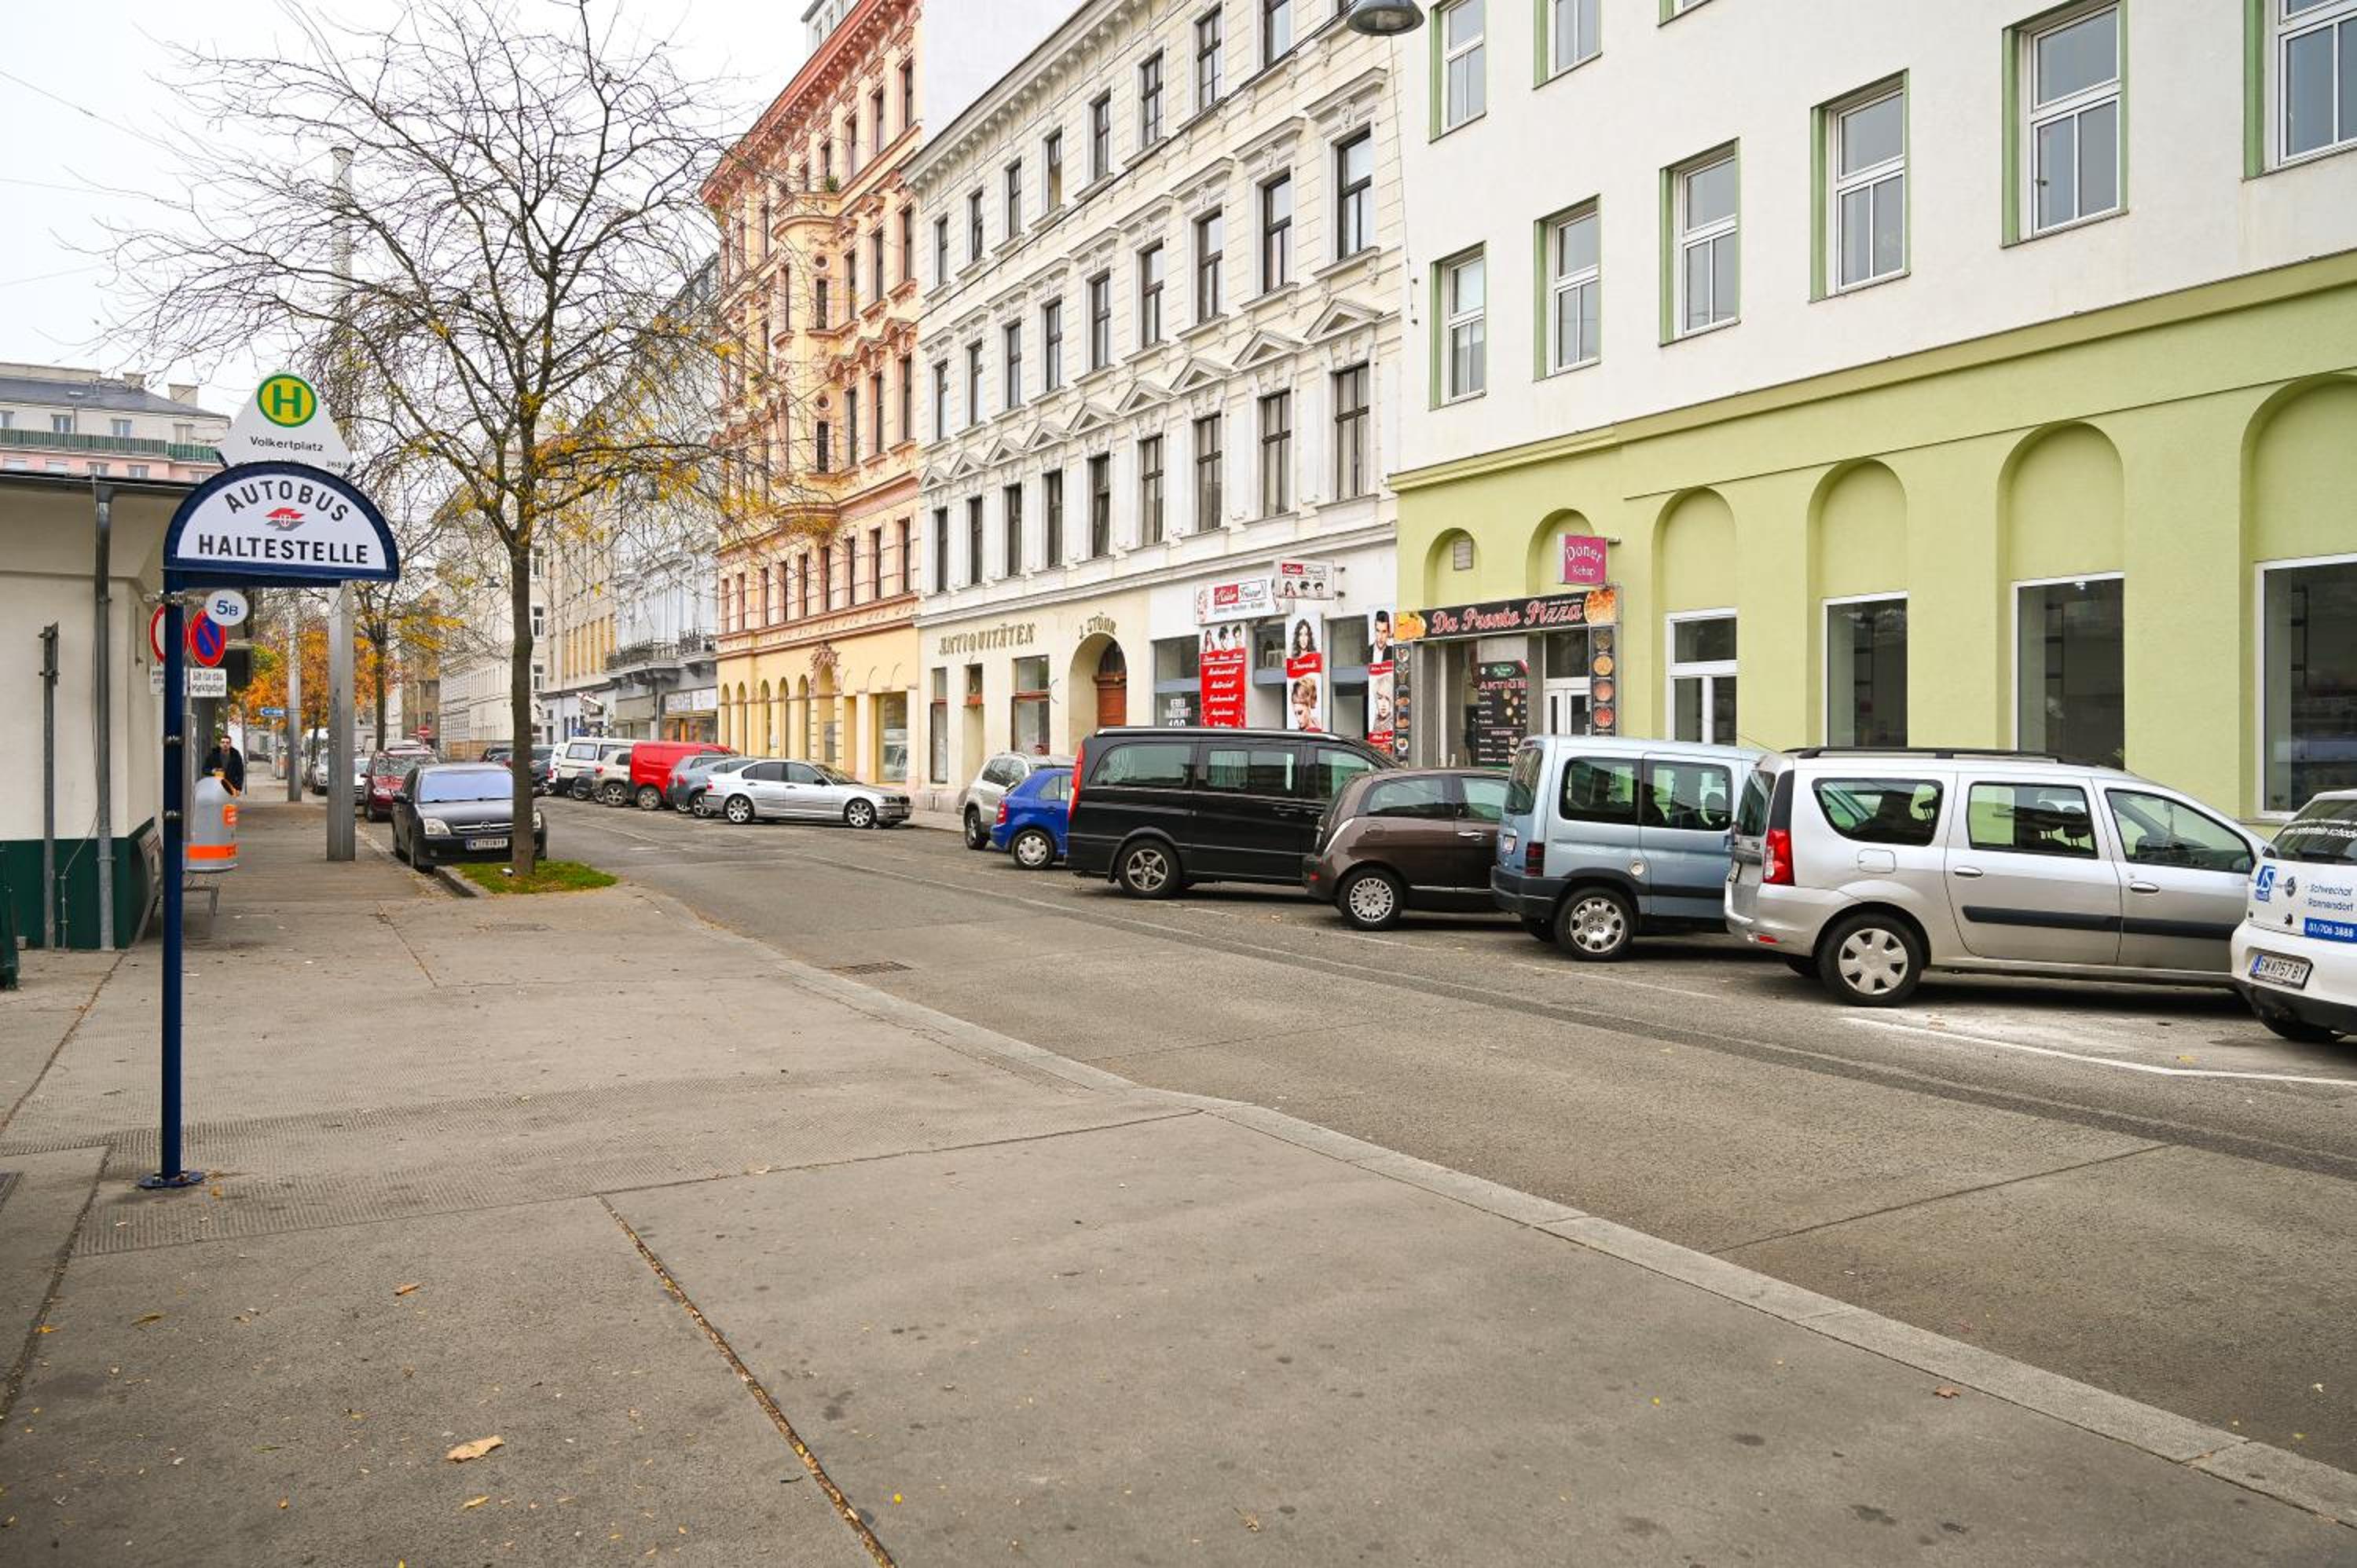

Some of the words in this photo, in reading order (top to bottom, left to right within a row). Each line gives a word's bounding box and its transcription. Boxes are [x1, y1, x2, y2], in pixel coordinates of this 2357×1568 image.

[273, 383, 301, 418] H
[250, 436, 324, 452] Volkertplatz
[225, 480, 350, 522] AUTOBUS
[199, 533, 368, 565] HALTESTELLE
[1431, 610, 1459, 634] Da
[1524, 599, 1584, 625] Pizza
[939, 622, 1036, 655] ANTIQUITÄTEN
[2310, 885, 2353, 897] Schwechat
